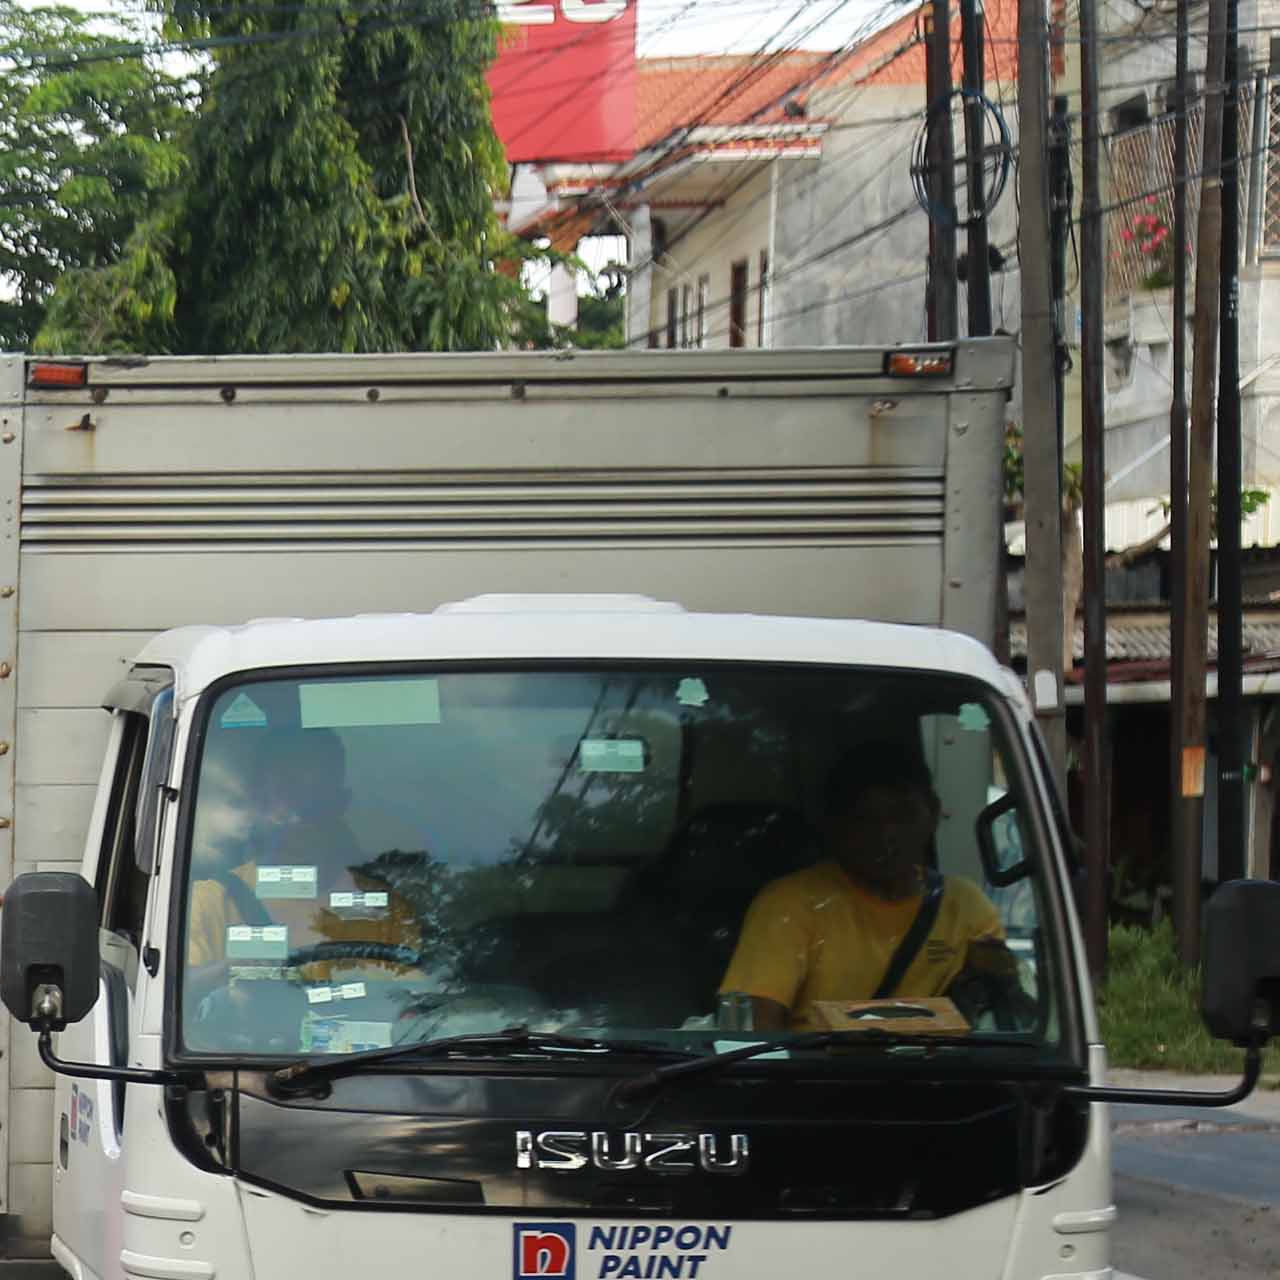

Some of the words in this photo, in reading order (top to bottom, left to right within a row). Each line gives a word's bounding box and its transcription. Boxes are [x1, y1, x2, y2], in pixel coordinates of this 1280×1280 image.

[516, 1131, 748, 1172] ISUZU
[587, 1225, 733, 1250] NIPPON
[597, 1255, 708, 1279] PAINT
